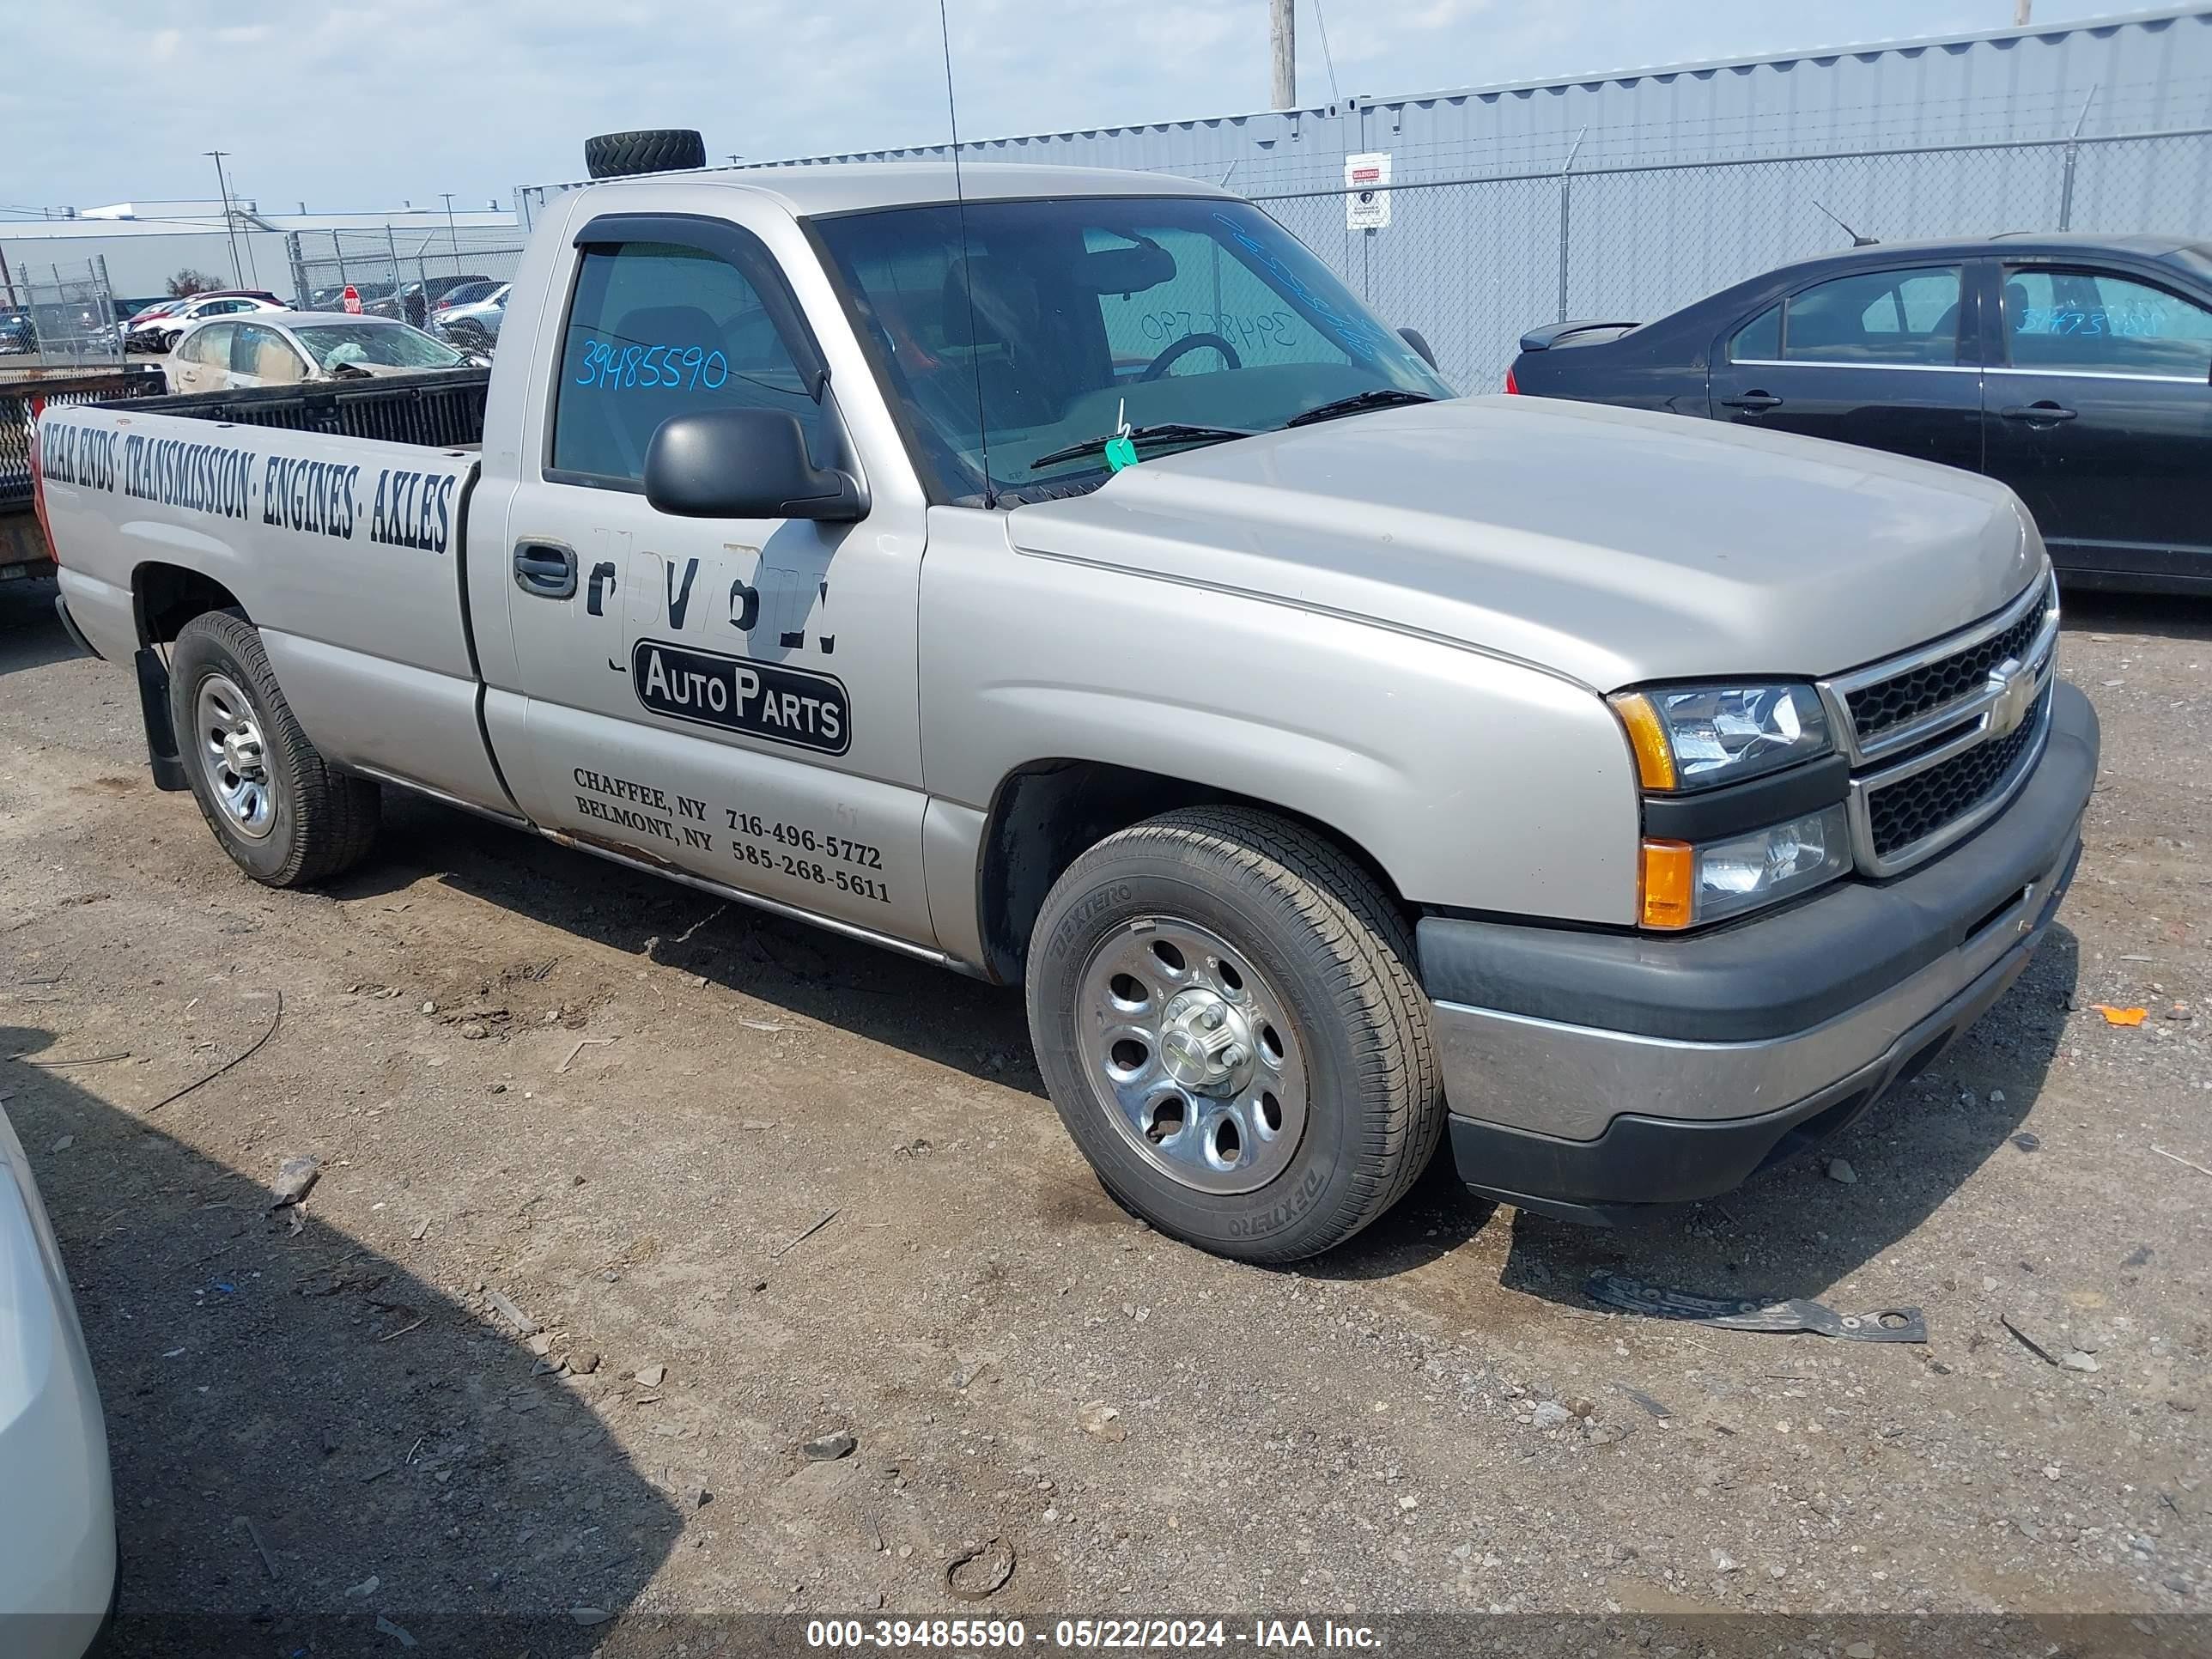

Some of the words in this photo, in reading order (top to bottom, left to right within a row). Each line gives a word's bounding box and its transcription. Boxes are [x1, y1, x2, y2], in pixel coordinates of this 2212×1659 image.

[345, 297, 360, 312] STOP
[576, 340, 728, 392] 39485590
[42, 423, 76, 483] REAR
[79, 428, 118, 494] ENDS
[125, 434, 256, 522] TRANSMISSION
[263, 457, 359, 541] ENGINES
[370, 469, 456, 555] AXLES
[574, 768, 674, 817] CHAFFEE,
[677, 796, 707, 822] NY
[726, 808, 883, 871] 716-496-5772
[574, 795, 681, 847] BELMONT,
[682, 826, 714, 853] NY
[732, 841, 892, 904] 585-268-5611
[1048, 883, 1132, 962] DEXTERO
[1228, 1168, 1325, 1237] DEXTERO
